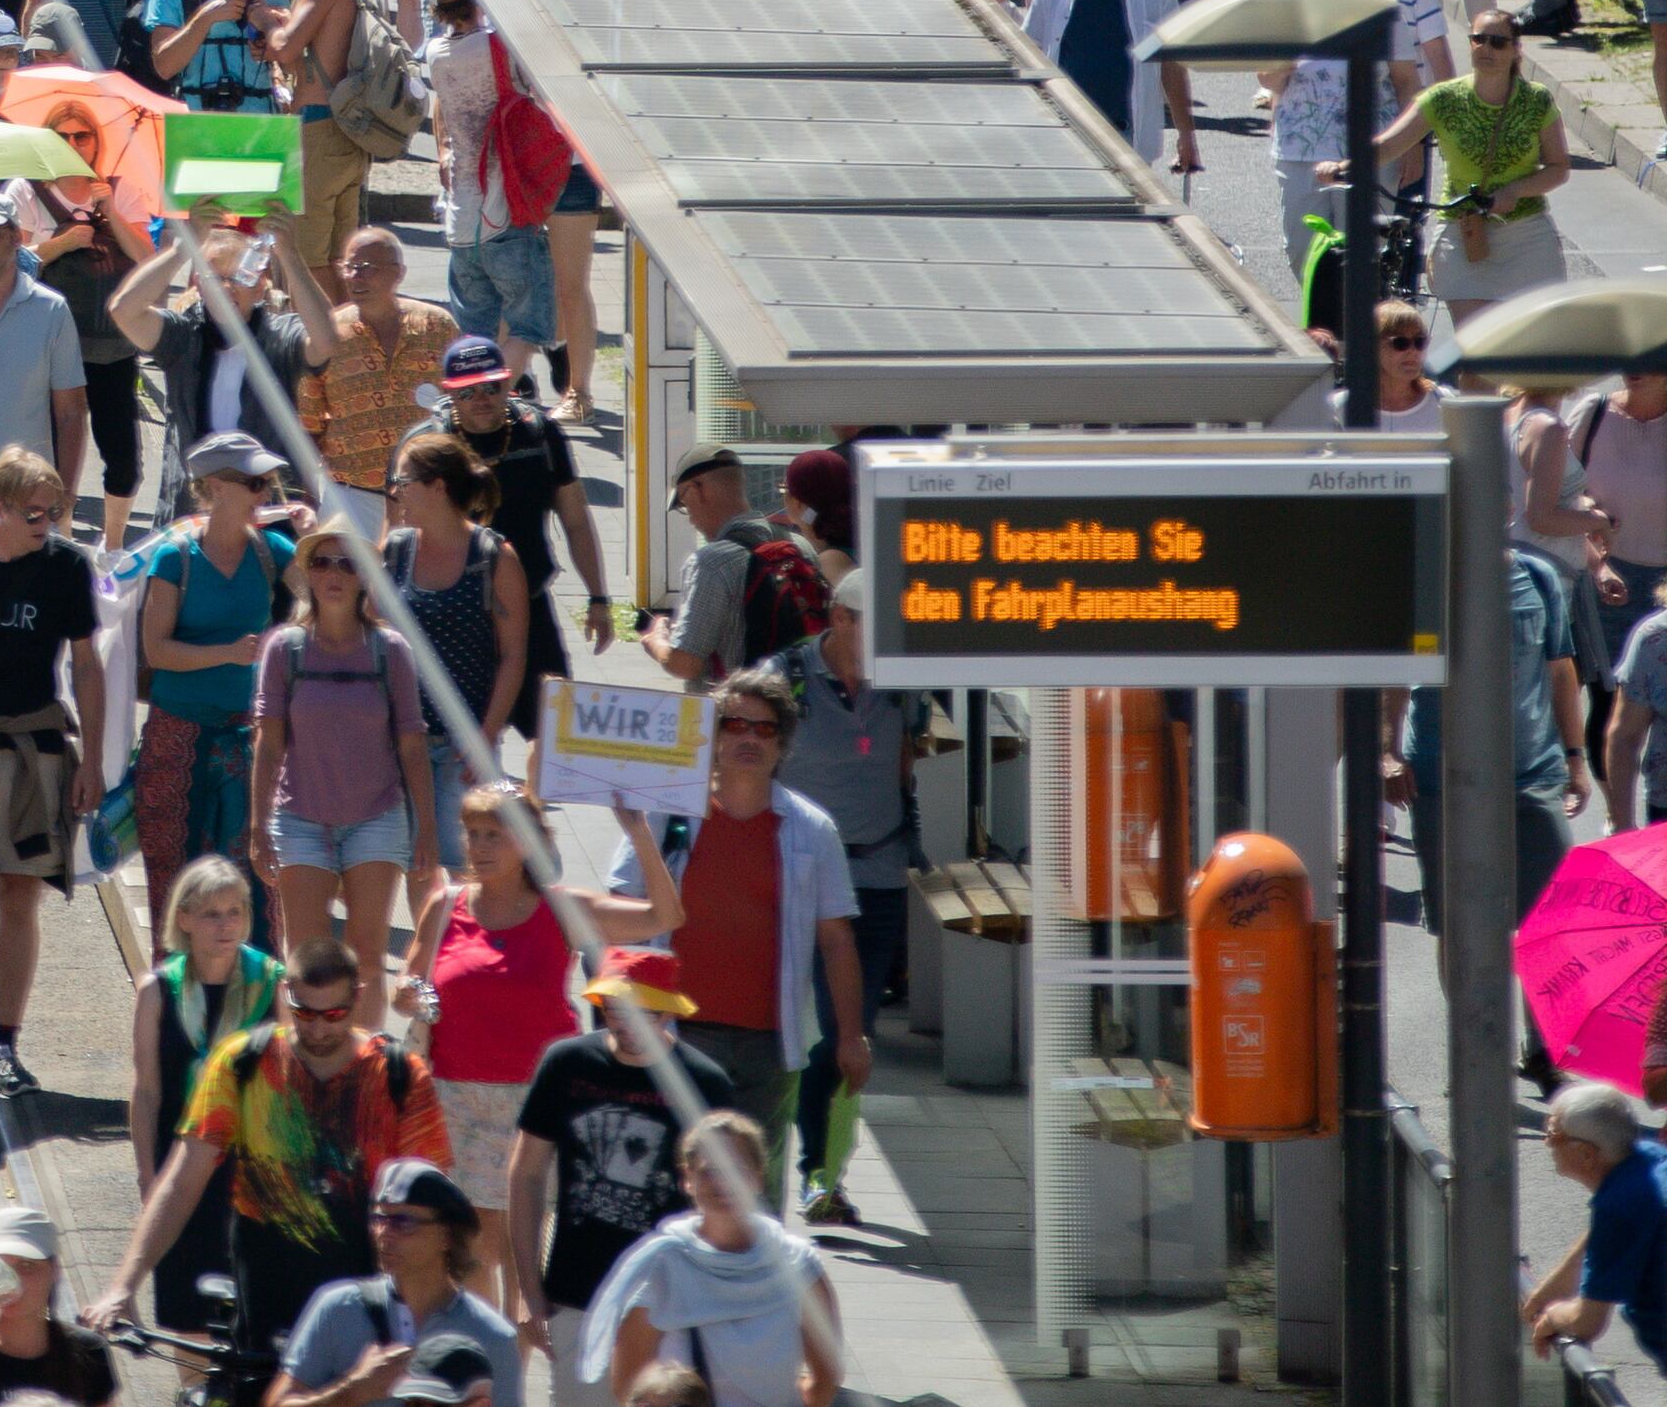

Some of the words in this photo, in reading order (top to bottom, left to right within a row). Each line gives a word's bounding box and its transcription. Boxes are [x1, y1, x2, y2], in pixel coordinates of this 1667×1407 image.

[907, 473, 955, 493] Linie
[975, 472, 1012, 492] Ziel
[1309, 470, 1387, 491] Abfahrt
[1393, 471, 1412, 490] in
[901, 519, 983, 565] Bitte
[990, 518, 1140, 564] beachten
[1149, 517, 1206, 563] Sie
[902, 580, 961, 622] den
[971, 578, 1241, 632] Fahrplanaushang
[575, 697, 651, 742] WIR
[658, 711, 677, 726] 20
[657, 729, 676, 743] 20
[1226, 1022, 1260, 1048] BSR
